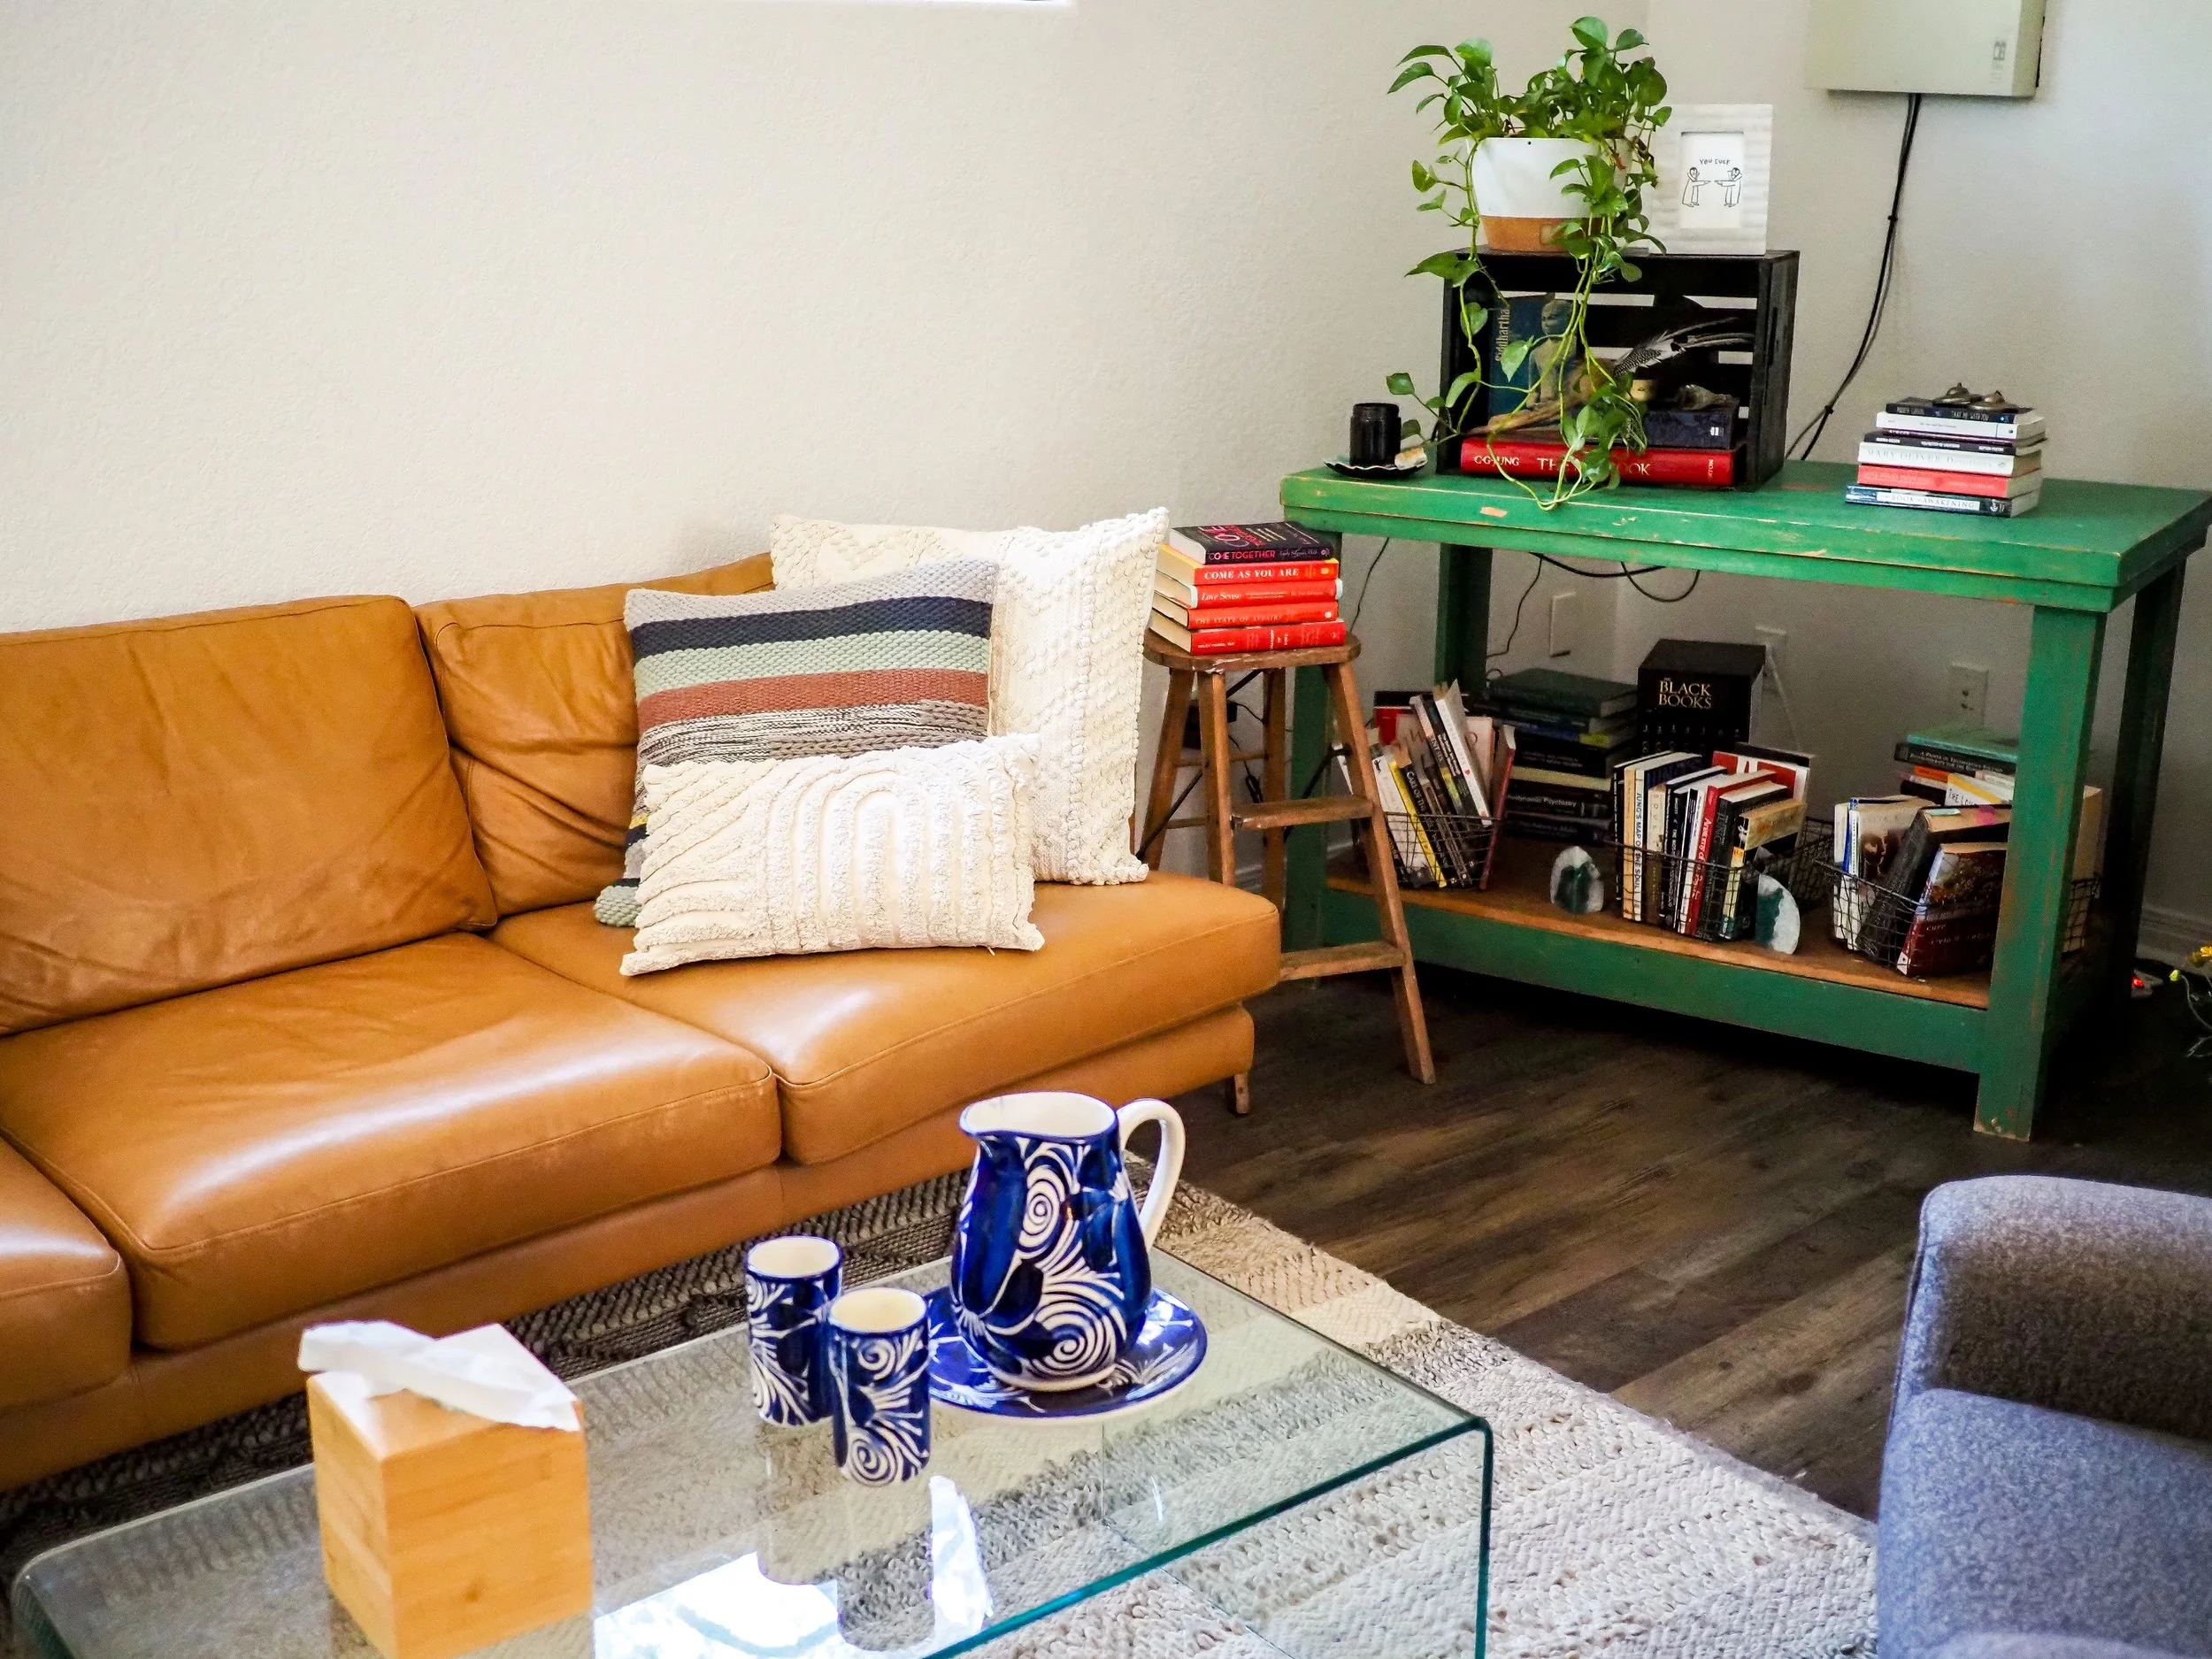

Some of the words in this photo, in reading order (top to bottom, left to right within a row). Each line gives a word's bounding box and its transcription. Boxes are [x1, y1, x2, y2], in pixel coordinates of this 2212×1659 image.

[1922, 497, 1975, 509] AWAKENING
[1231, 549, 1276, 559] TOGETHER
[1204, 570, 1234, 580] COME
[1239, 570, 1251, 579] AS
[1254, 569, 1273, 578] YOU
[1279, 568, 1299, 577] ARE
[1201, 592, 1219, 601] Love
[1219, 591, 1242, 601] Sense
[1252, 614, 1283, 623] AFFAIRS
[1659, 680, 1713, 697] BLACK
[1658, 693, 1713, 709] BOOKS
[1699, 817, 1712, 854] Anatomy
